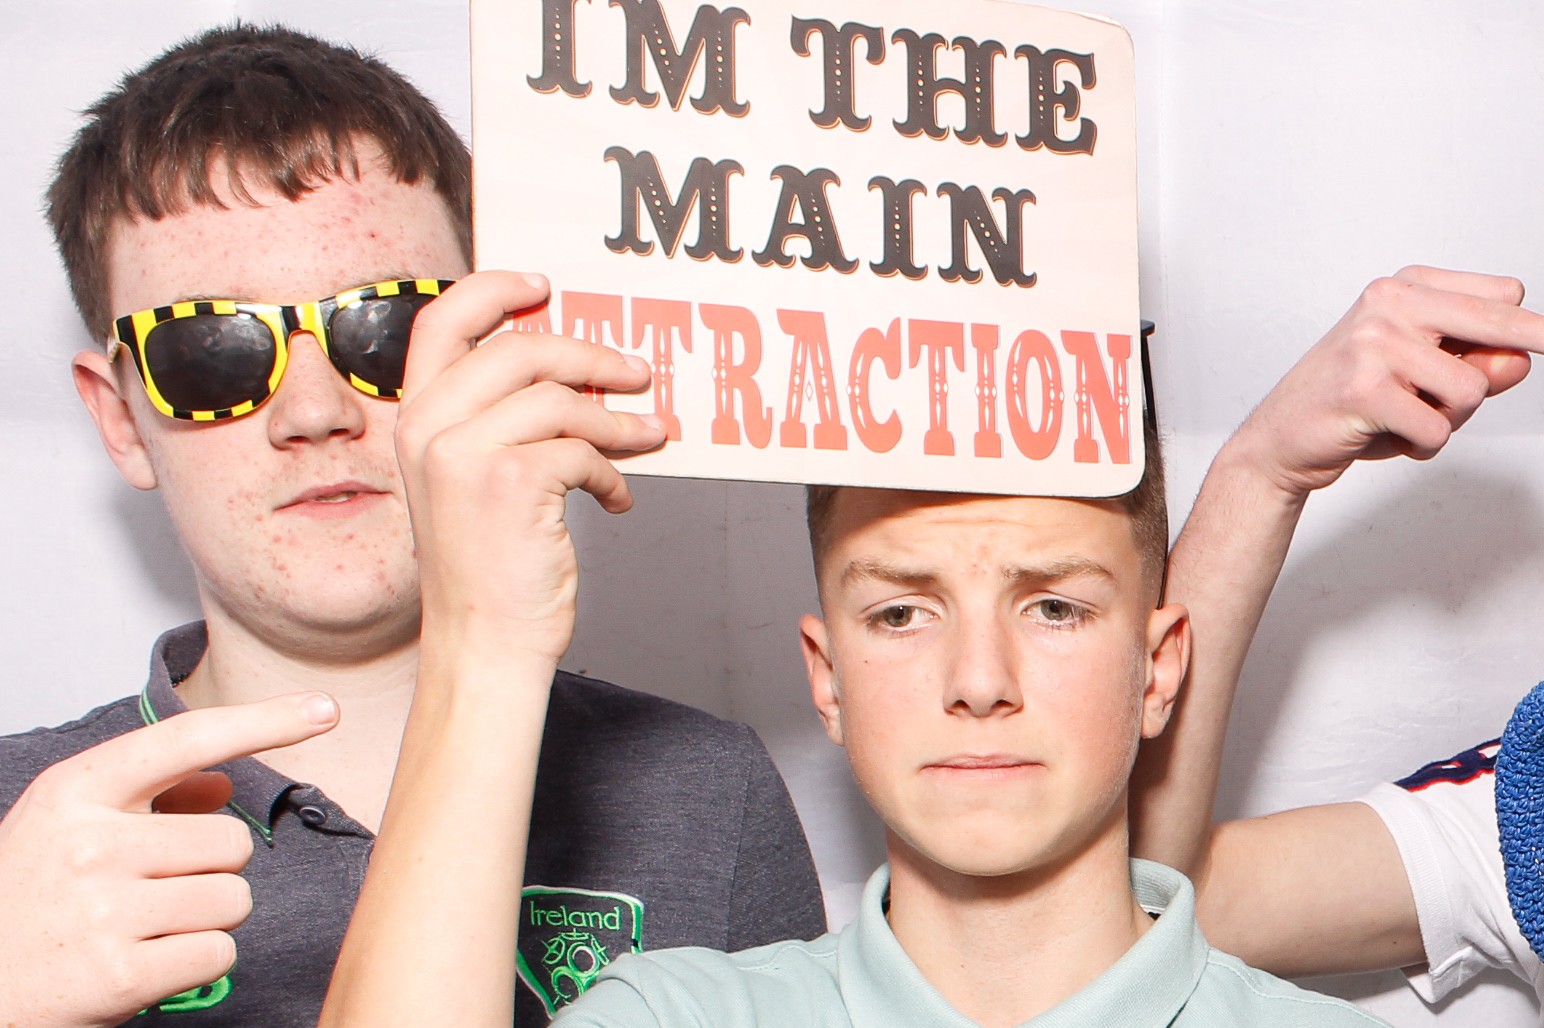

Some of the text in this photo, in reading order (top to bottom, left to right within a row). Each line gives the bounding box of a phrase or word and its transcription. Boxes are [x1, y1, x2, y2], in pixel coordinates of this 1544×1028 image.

[791, 14, 1098, 156] THE
[603, 145, 1037, 288] MAIN
[512, 290, 1133, 465] TTRACTION
[529, 900, 623, 931] Ireland
